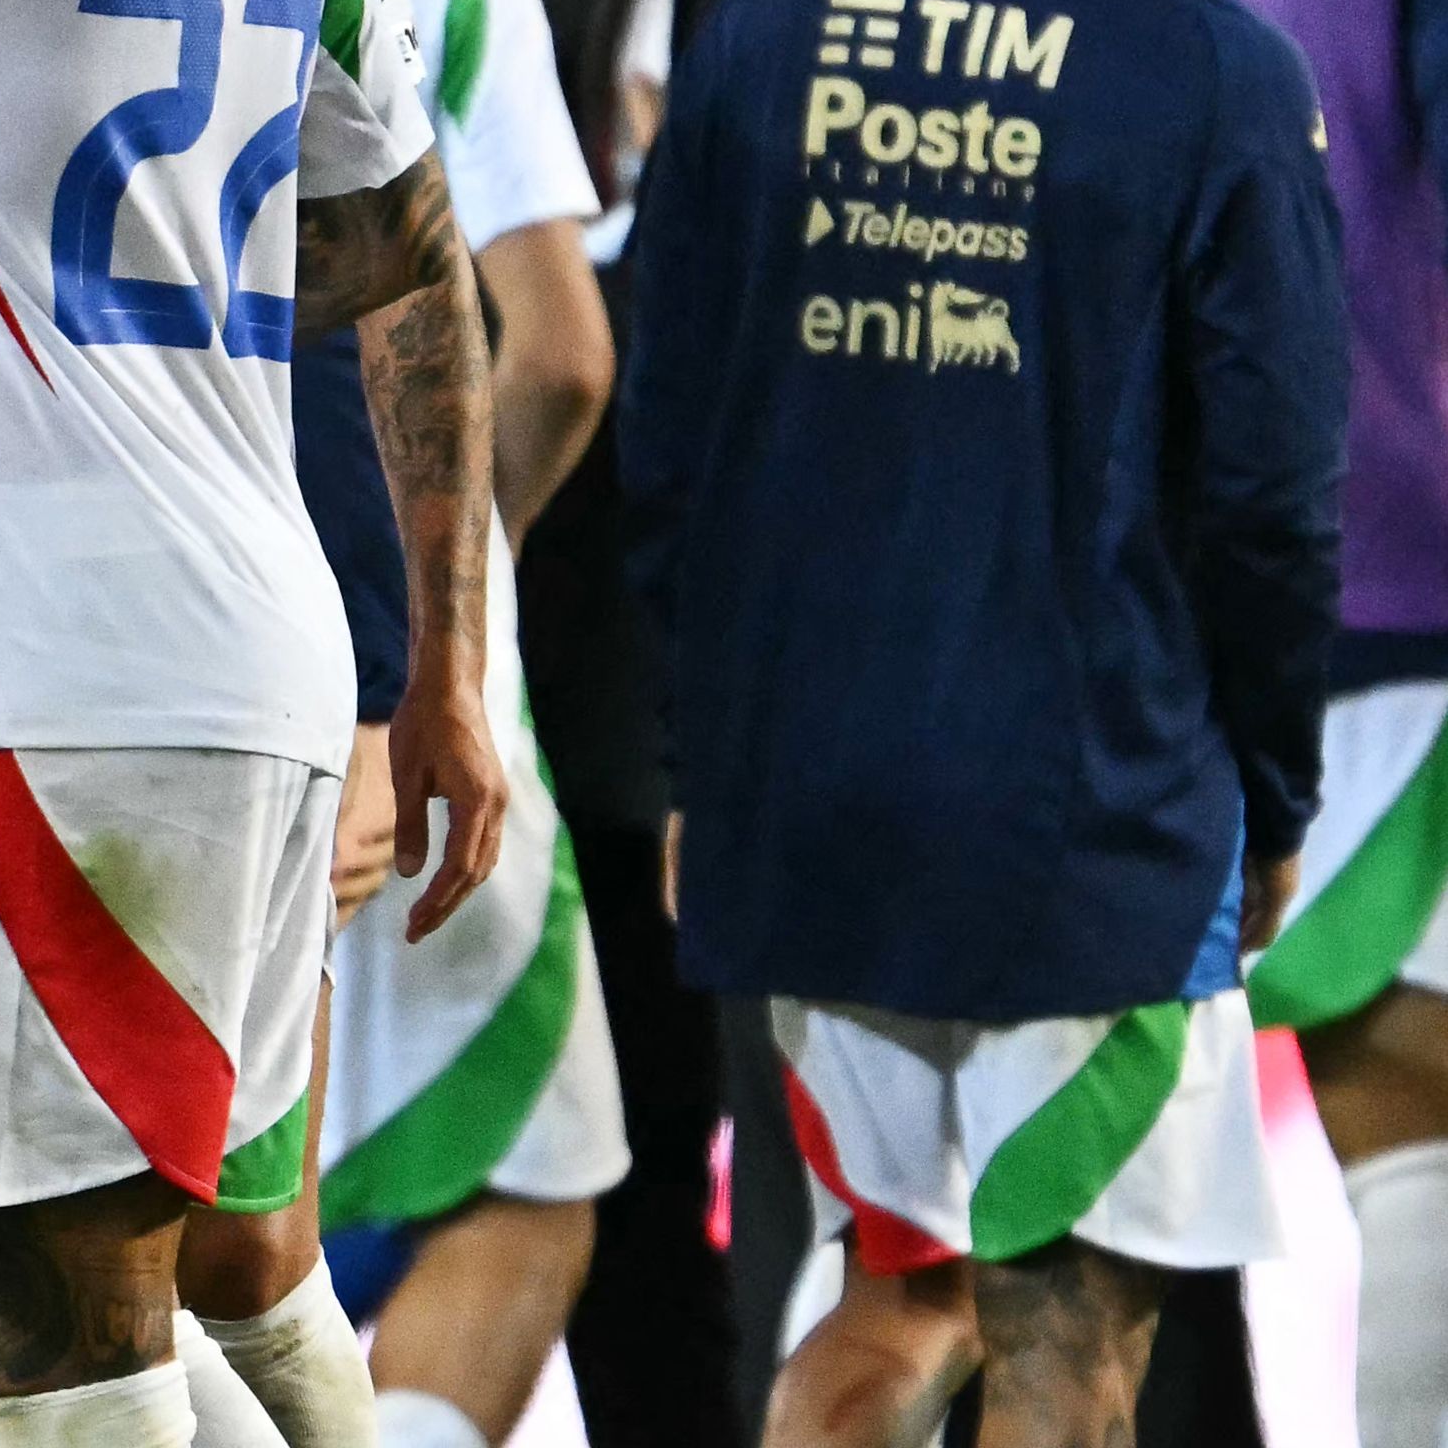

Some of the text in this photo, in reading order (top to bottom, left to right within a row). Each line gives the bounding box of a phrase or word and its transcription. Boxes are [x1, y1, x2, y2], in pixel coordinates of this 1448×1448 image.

[805, 75, 1042, 178] Poste
[843, 200, 1029, 262] Telepass
[802, 282, 924, 360] eni
